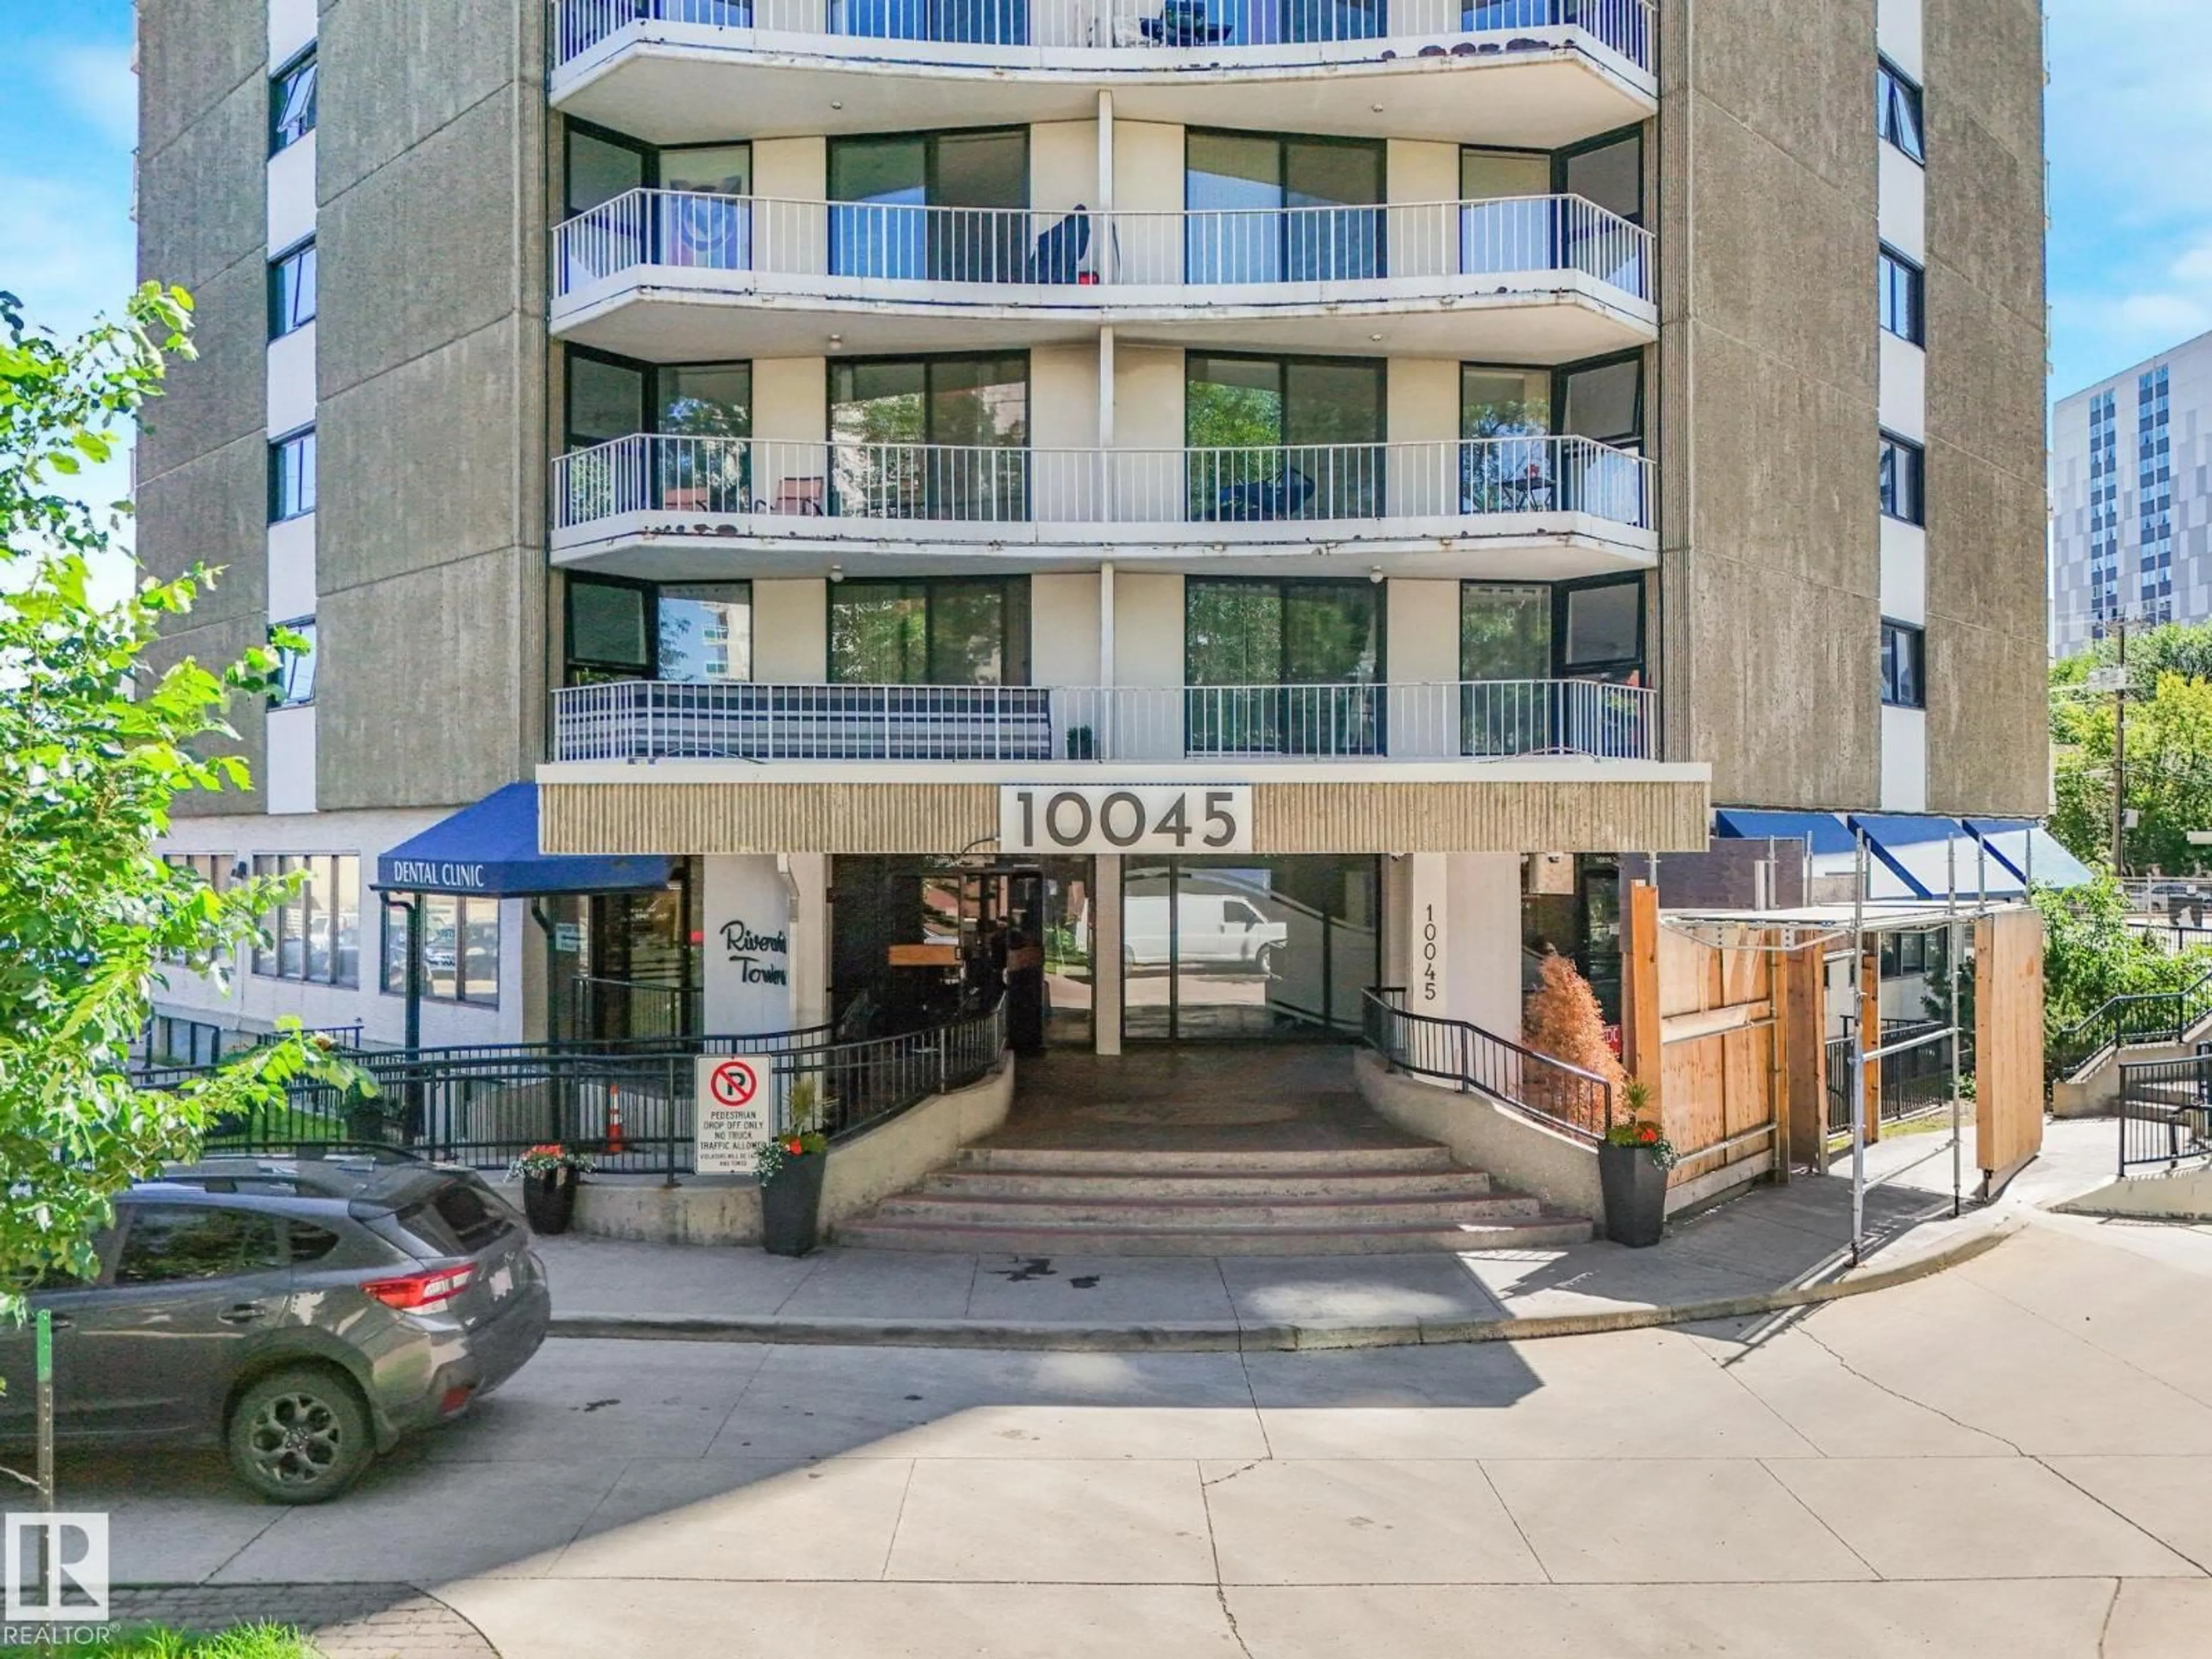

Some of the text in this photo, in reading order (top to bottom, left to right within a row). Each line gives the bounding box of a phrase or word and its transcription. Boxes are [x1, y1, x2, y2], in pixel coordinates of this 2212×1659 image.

[1017, 791, 1236, 847] 10045
[394, 861, 484, 887] DENTAL CLINIC
[1424, 904, 1437, 1001] 10045
[711, 1111, 756, 1119] PEDESTRIAN
[703, 1121, 764, 1129] DROP OFF ONLY
[715, 1131, 753, 1139] NO TRUCK
[700, 1141, 730, 1150] TRAFFIC
